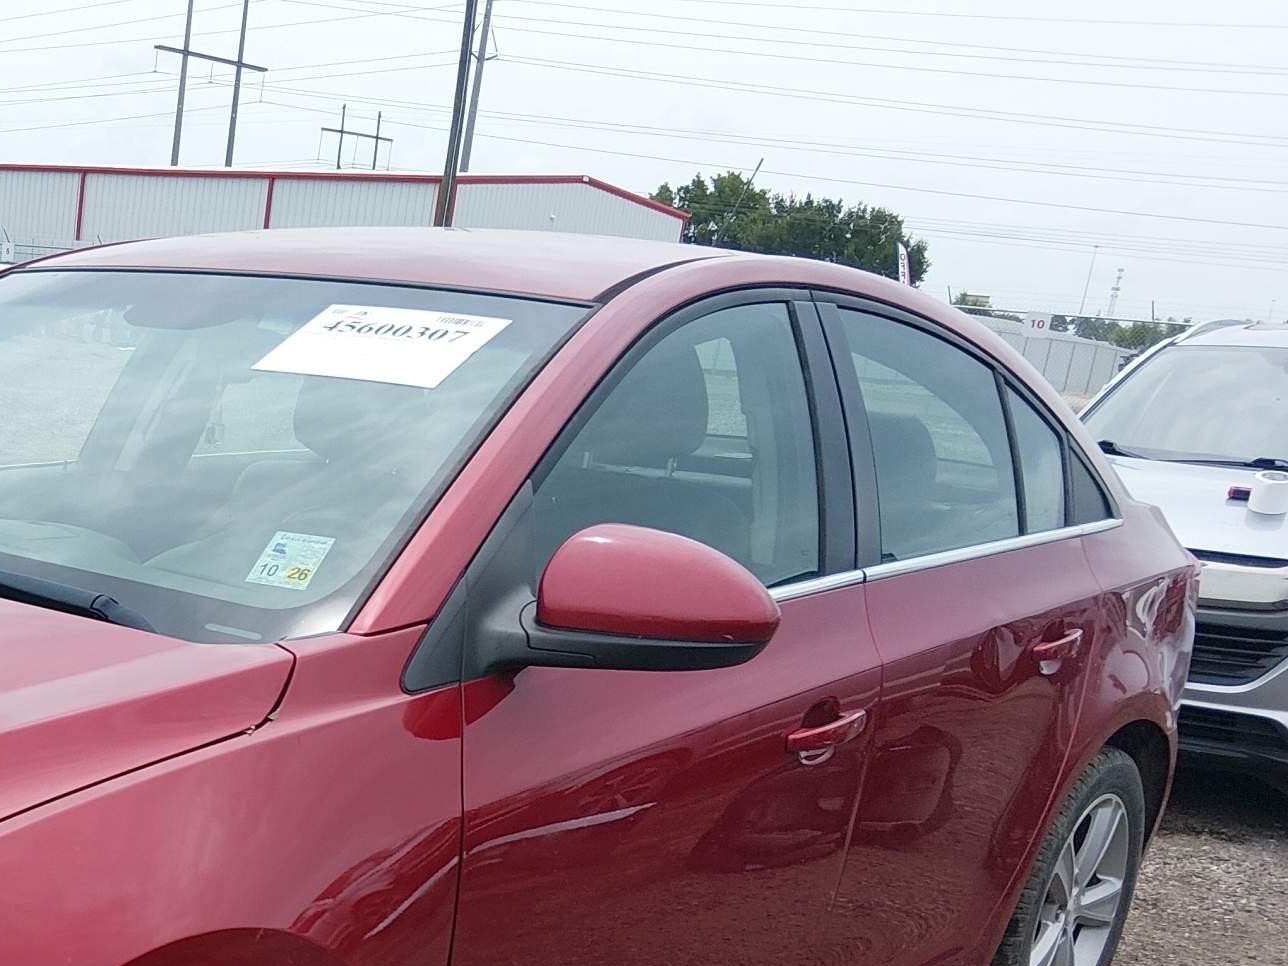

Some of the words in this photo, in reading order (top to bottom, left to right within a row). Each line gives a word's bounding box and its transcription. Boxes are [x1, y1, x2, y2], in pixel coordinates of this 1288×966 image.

[322, 319, 471, 343] 45600307
[1030, 319, 1045, 329] 10
[260, 563, 279, 577] 10
[287, 567, 311, 581] 26
